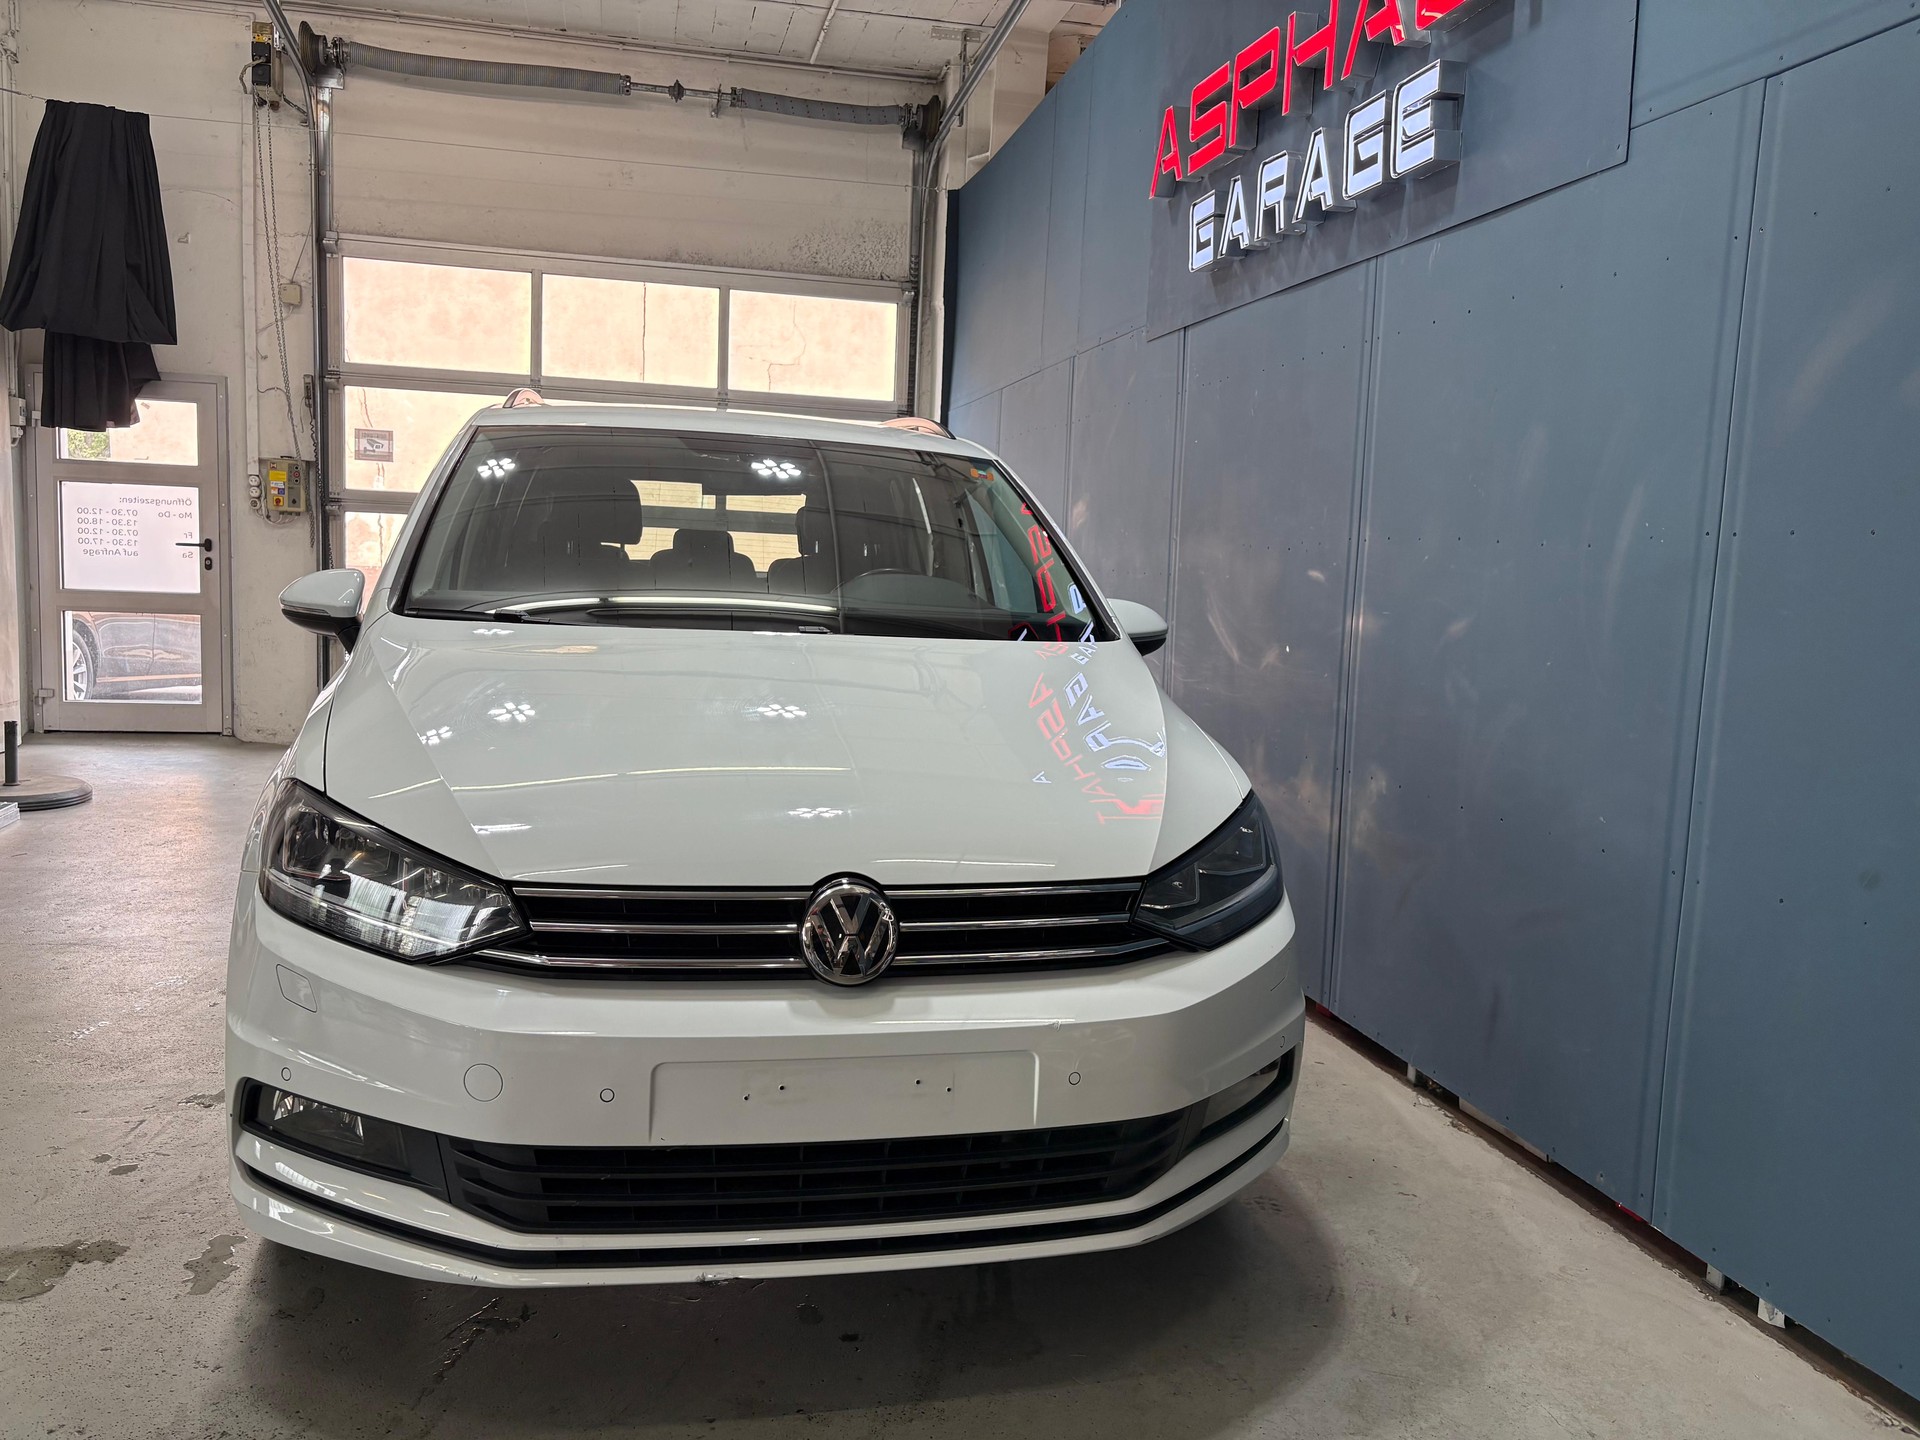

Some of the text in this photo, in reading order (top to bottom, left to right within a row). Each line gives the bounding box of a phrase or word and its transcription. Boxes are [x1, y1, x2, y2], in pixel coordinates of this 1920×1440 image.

[1148, 0, 1468, 200] ASPHA
[1188, 59, 1442, 272] GARAGE
[805, 887, 894, 981] VW
